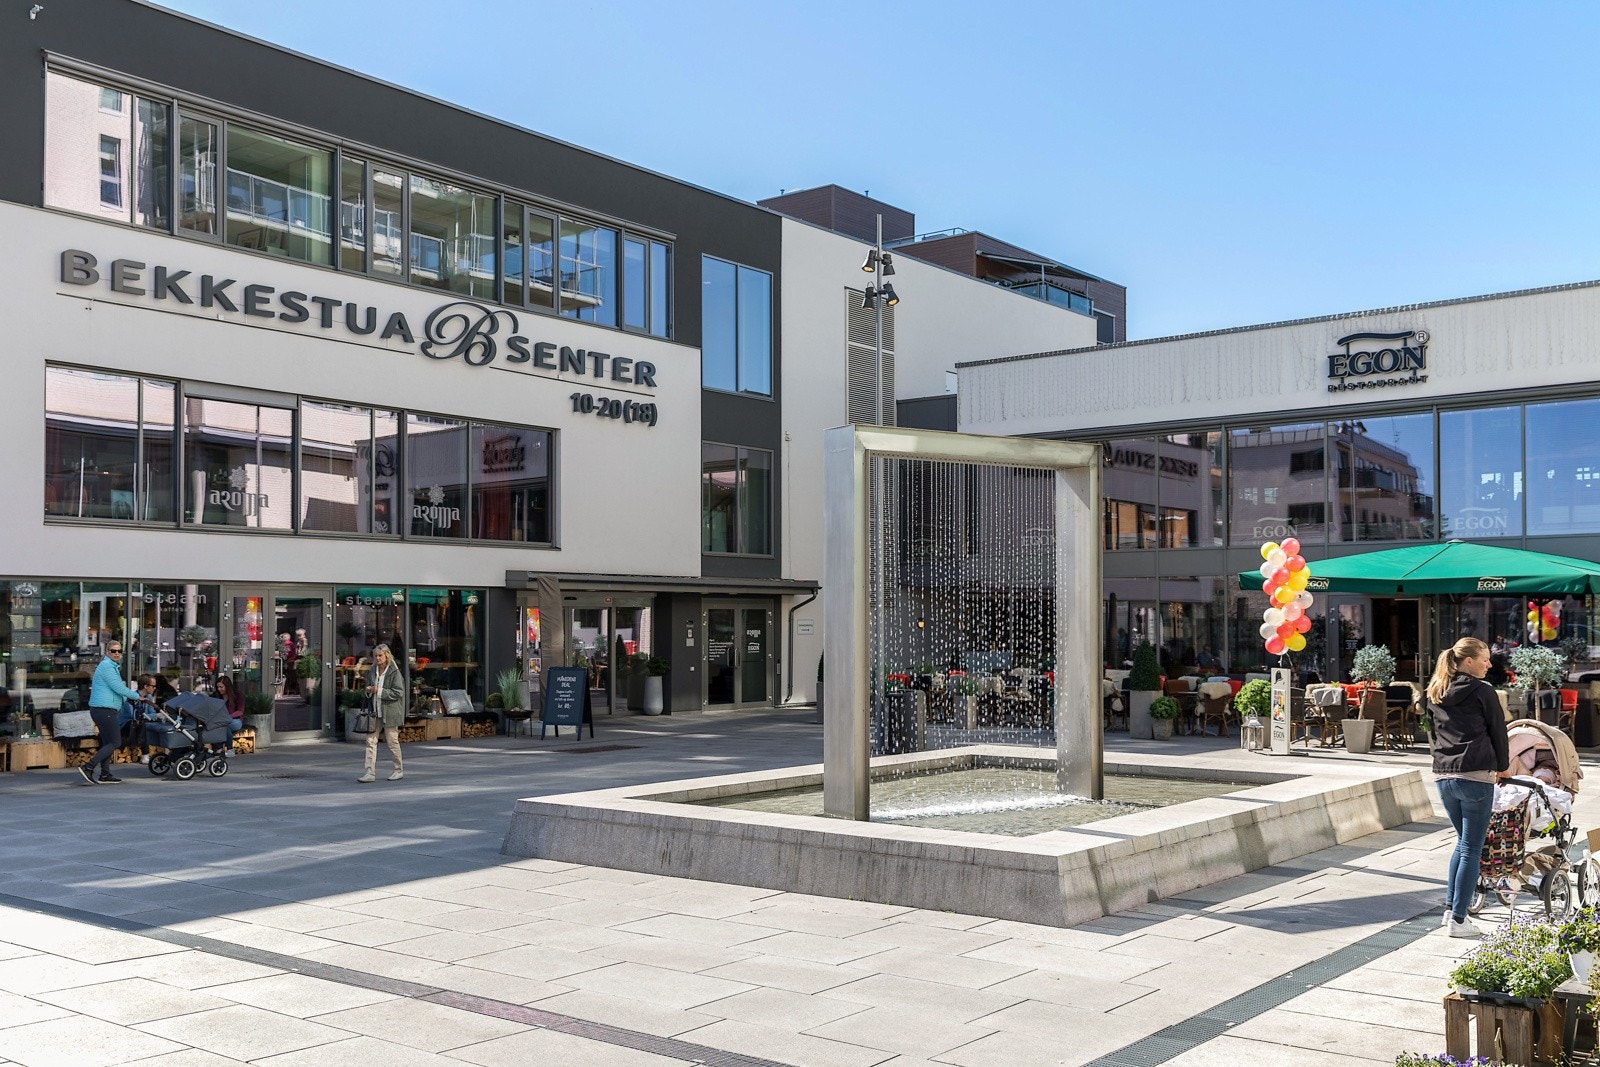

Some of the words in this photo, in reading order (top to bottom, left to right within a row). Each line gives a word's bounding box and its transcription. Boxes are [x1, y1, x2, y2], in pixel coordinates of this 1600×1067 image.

[60, 248, 414, 345] BEKKESTUA
[506, 335, 658, 388] SENTER
[1327, 345, 1428, 379] EGON
[1327, 374, 1429, 393] RESTAURANT
[569, 391, 658, 427] 10-20(18)
[1454, 515, 1508, 530] EGON
[1252, 524, 1299, 539] EGON
[1477, 580, 1507, 588] EGON
[144, 592, 207, 605] steam
